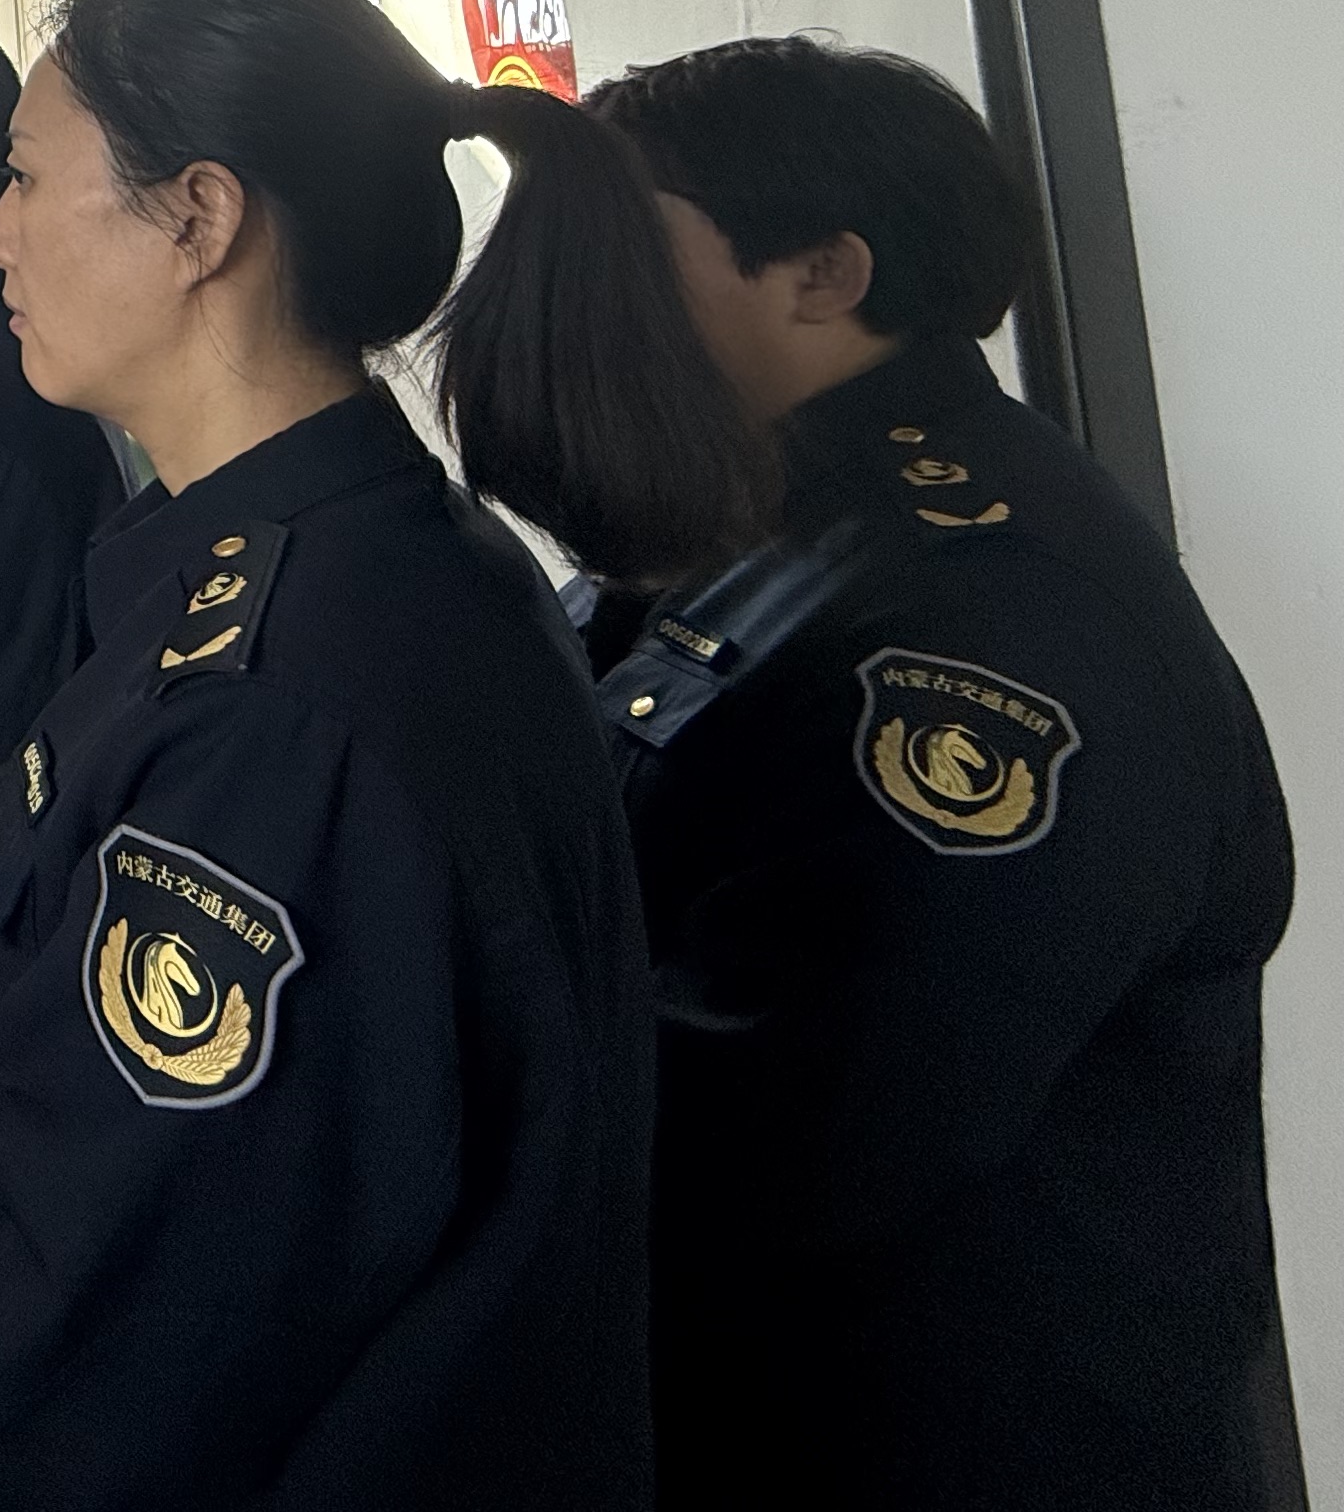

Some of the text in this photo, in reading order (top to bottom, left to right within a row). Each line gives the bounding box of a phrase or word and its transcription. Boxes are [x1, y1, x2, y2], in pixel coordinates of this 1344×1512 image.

[116, 850, 277, 955] 内蒙古交通集团
